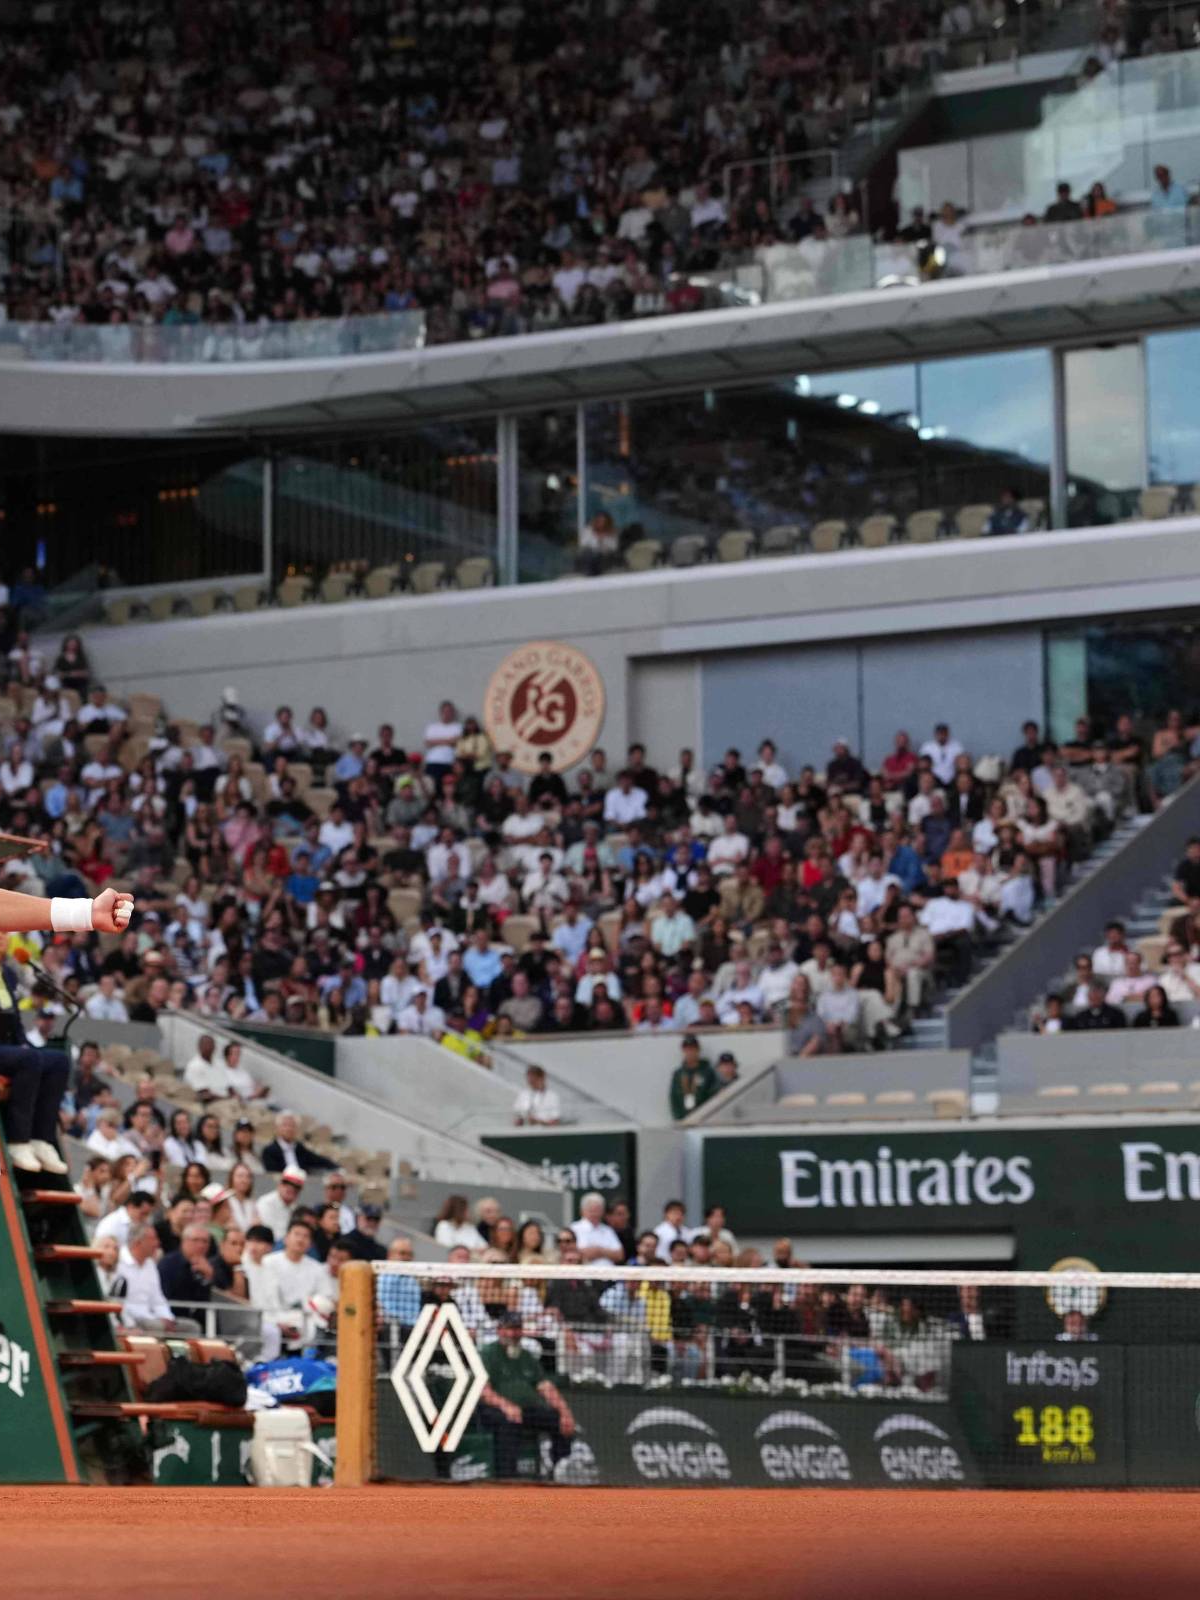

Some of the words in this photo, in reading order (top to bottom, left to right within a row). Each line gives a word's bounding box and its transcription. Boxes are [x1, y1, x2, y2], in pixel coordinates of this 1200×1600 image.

[779, 1146, 1036, 1208] Emirates
[1006, 1350, 1100, 1391] Infosys
[1013, 1405, 1094, 1446] 188
